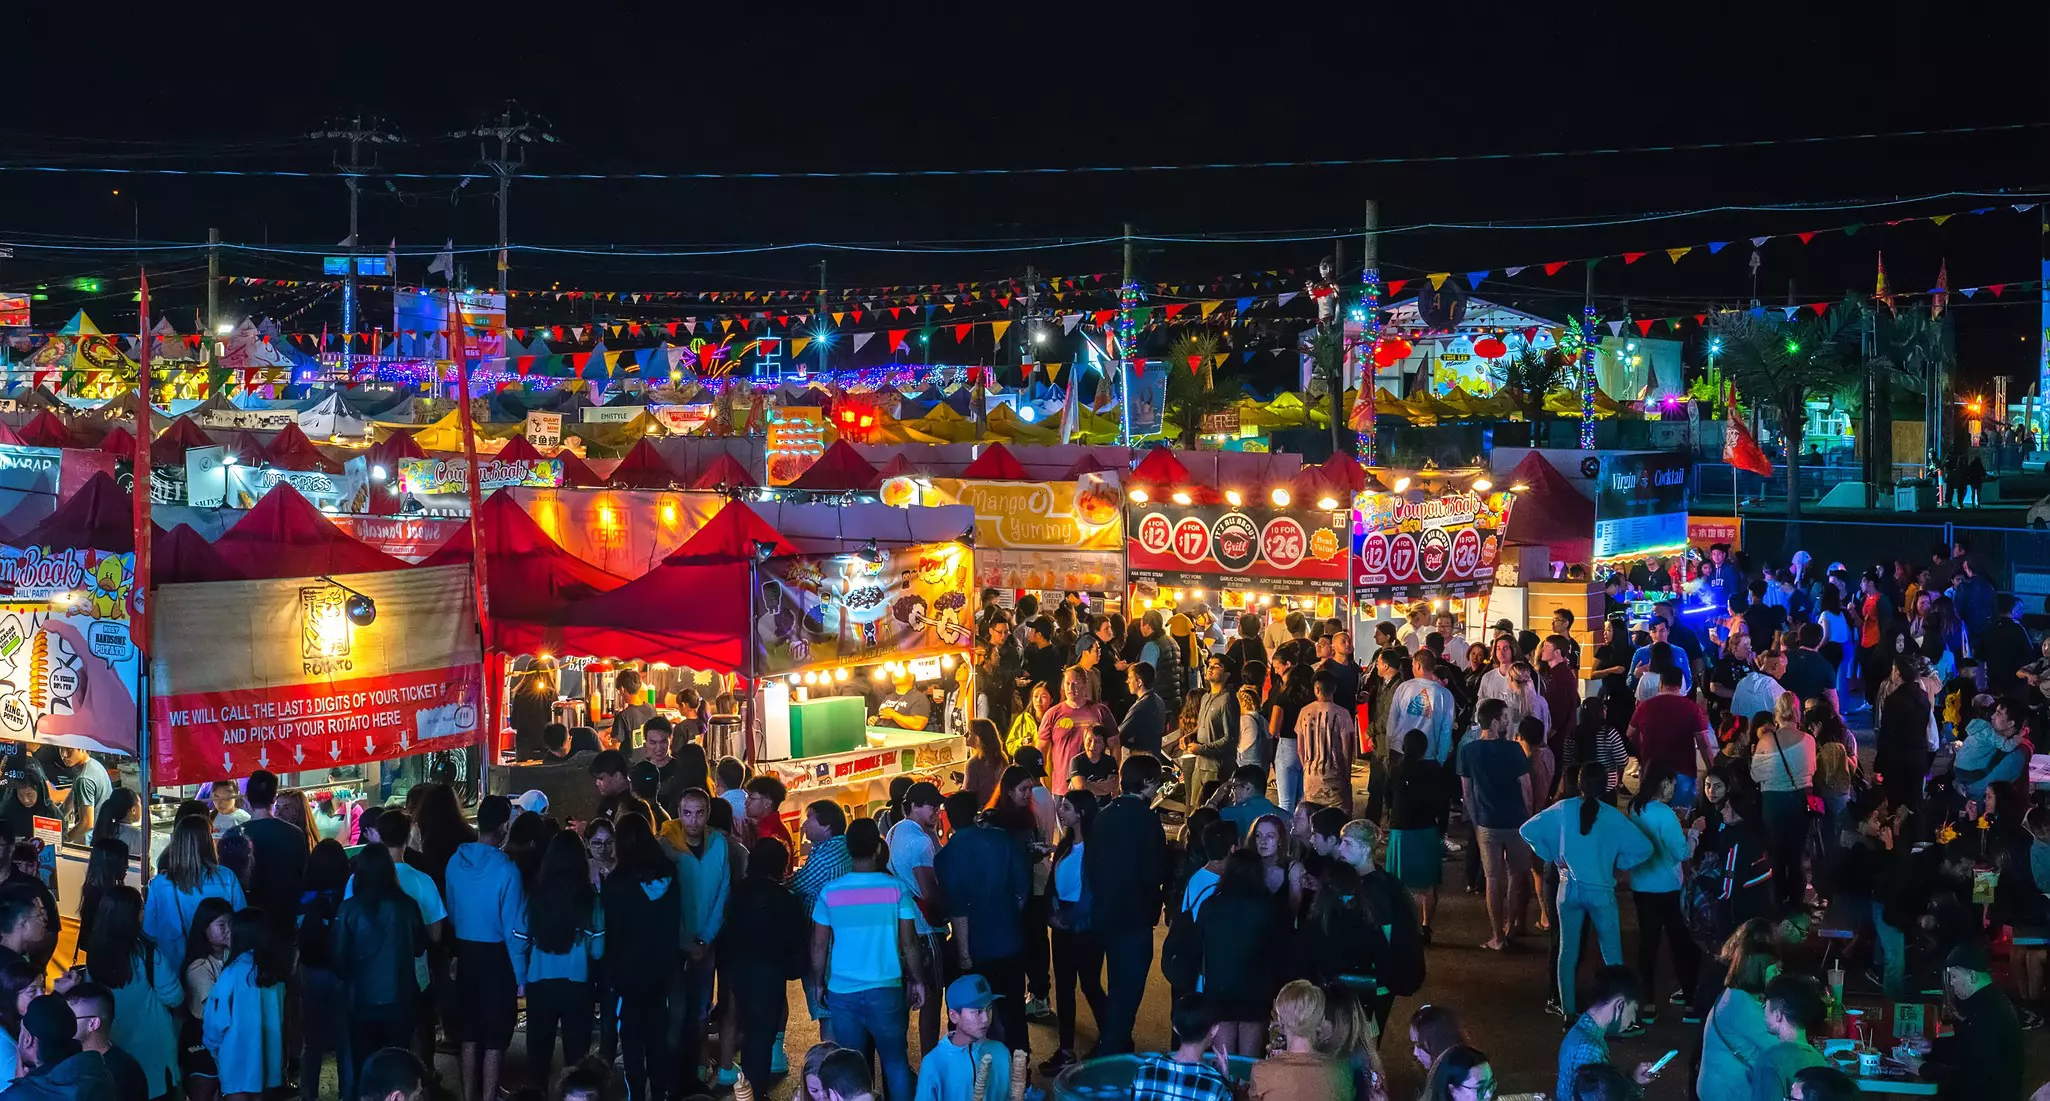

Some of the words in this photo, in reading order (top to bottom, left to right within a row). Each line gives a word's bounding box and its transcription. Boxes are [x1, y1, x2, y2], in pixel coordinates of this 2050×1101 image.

[434, 461, 490, 493] Coupn
[489, 460, 527, 482] Book
[1612, 472, 1636, 494] Virgin
[1654, 468, 1684, 487] Cocktail
[971, 489, 1027, 514] Mango
[1393, 495, 1443, 530] Coupon
[1445, 491, 1481, 514] Book
[1010, 517, 1071, 542] Yummy
[1144, 527, 1166, 547] $12
[1215, 522, 1225, 540] IT'S
[1224, 517, 1236, 527] ALL
[1237, 517, 1256, 540] ABOUT
[1465, 535, 1475, 543] FOR
[1179, 533, 1203, 555] $17
[1224, 540, 1247, 555] Grill
[1266, 535, 1300, 560] $26
[1314, 543, 1333, 553] Value
[1317, 536, 1332, 545] Best
[1366, 547, 1382, 567] $12
[1393, 549, 1411, 571] $17
[1426, 553, 1443, 566] Grill
[1455, 544, 1476, 566] $26
[20, 545, 84, 588] Book
[32, 589, 51, 598] PARTY
[95, 643, 125, 656] POTATO
[5, 703, 20, 717] KING
[170, 711, 189, 727] WE
[192, 708, 217, 725] WILL
[221, 704, 251, 722] CALL
[253, 702, 275, 719] THE
[278, 699, 304, 717] LAST
[307, 699, 312, 714] 3
[315, 695, 350, 713] DIGITS
[352, 692, 367, 708] OF
[369, 689, 399, 706] YOUR
[400, 684, 437, 701] TICKET
[440, 682, 446, 694] #
[4, 712, 23, 725] POTATO
[223, 728, 247, 745] AND
[250, 725, 276, 742] PICK
[278, 723, 292, 739] UP
[295, 719, 324, 738] YOUR
[328, 714, 370, 734] ROTATO
[372, 710, 401, 729] HERE
[835, 761, 853, 778] BEST
